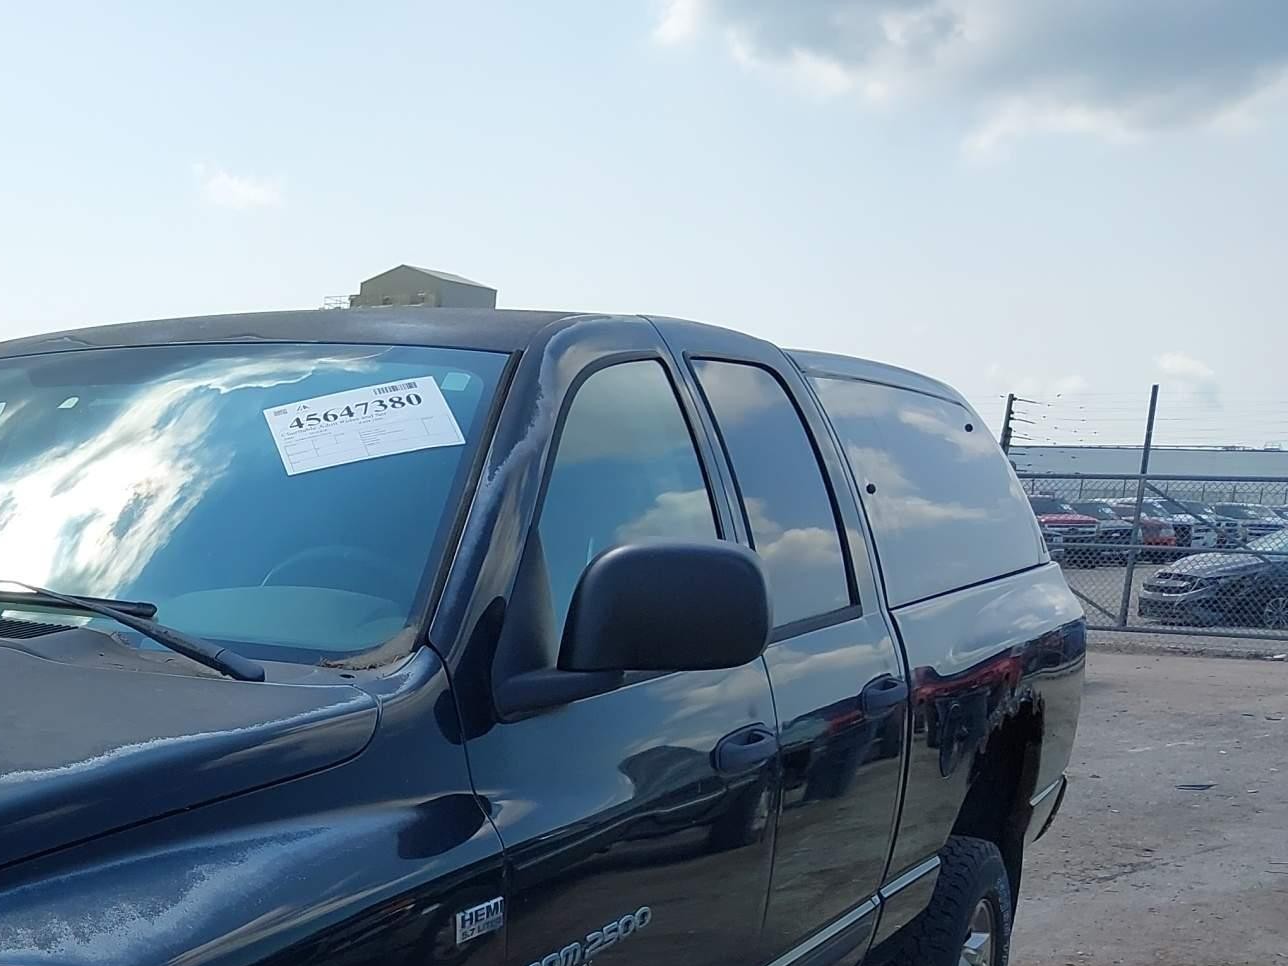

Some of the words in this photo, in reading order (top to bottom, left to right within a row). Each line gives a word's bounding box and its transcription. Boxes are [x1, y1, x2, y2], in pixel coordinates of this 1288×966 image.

[289, 393, 423, 429] 45647380
[460, 899, 505, 929] HEMI
[583, 906, 652, 961] 2500
